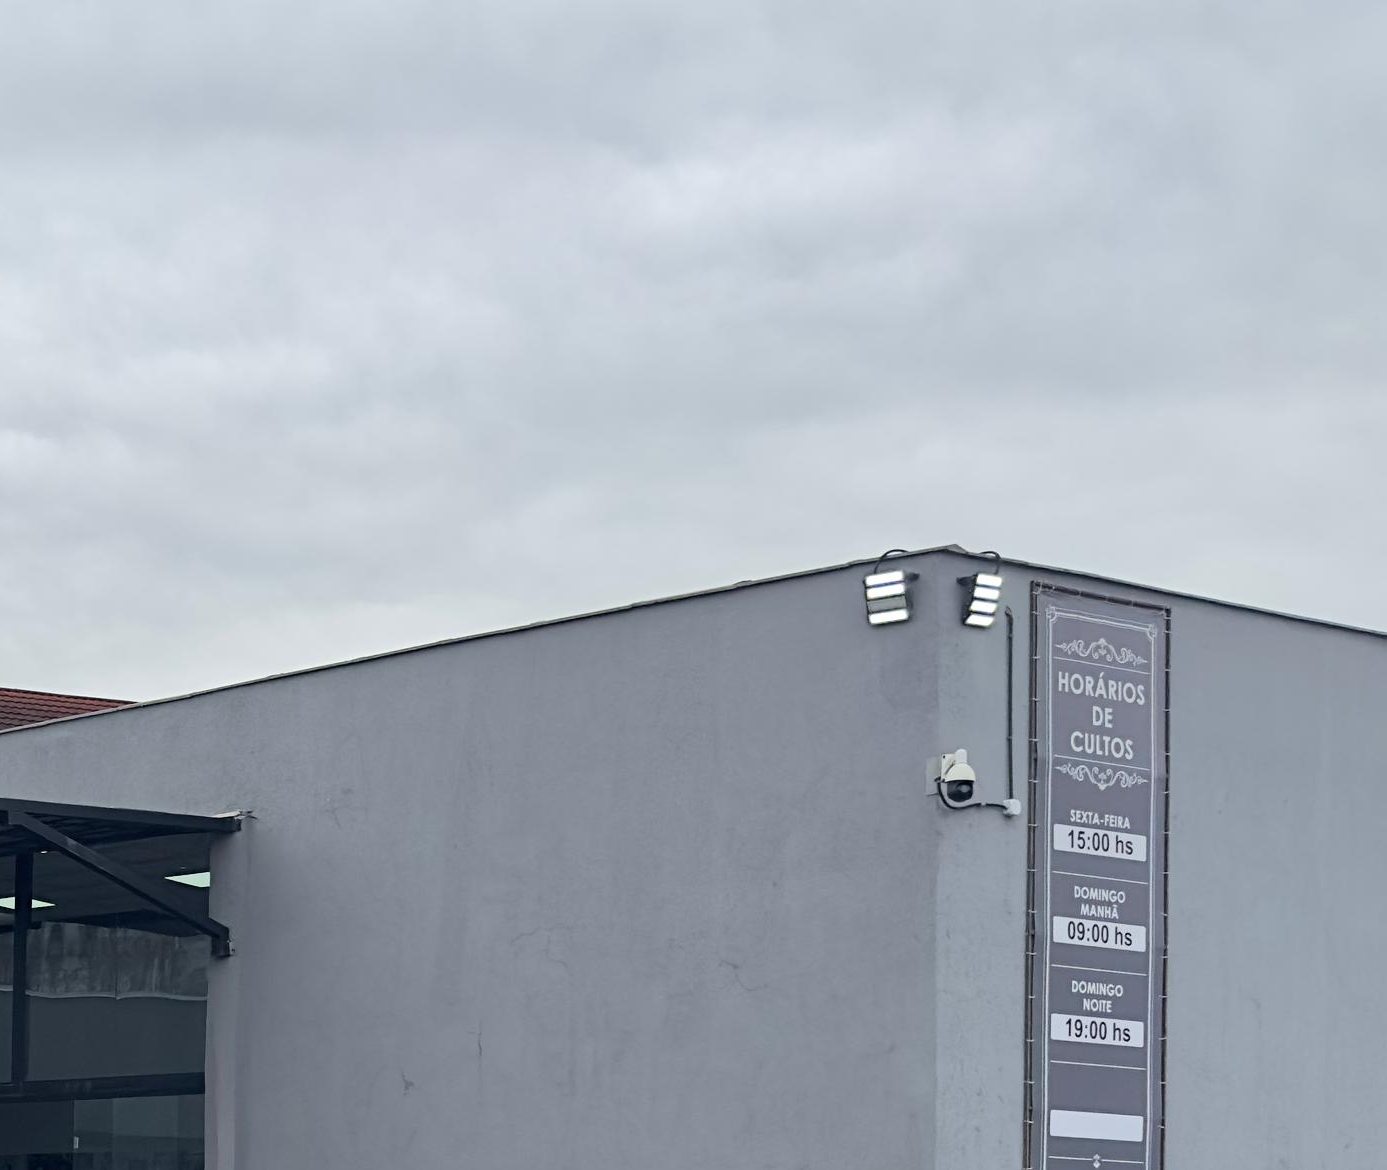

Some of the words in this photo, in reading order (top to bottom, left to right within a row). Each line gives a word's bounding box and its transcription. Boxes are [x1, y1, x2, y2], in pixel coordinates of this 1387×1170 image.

[1058, 671, 1145, 706] HORÁRIOS
[1092, 705, 1114, 728] DE
[1070, 731, 1134, 760] CULTOS
[1070, 809, 1131, 830] SEXTA-FEIRA
[1068, 829, 1110, 852] 15:00
[1115, 835, 1134, 855] hs
[1074, 885, 1126, 904] DOMINGO
[1080, 903, 1119, 920] MANHÃ
[1067, 921, 1109, 944] 09:00
[1114, 926, 1133, 947] hs
[1071, 980, 1124, 997] DOMINGO
[1083, 998, 1113, 1013] NOITE
[1065, 1018, 1108, 1041] 19:00
[1113, 1023, 1131, 1042] hs
